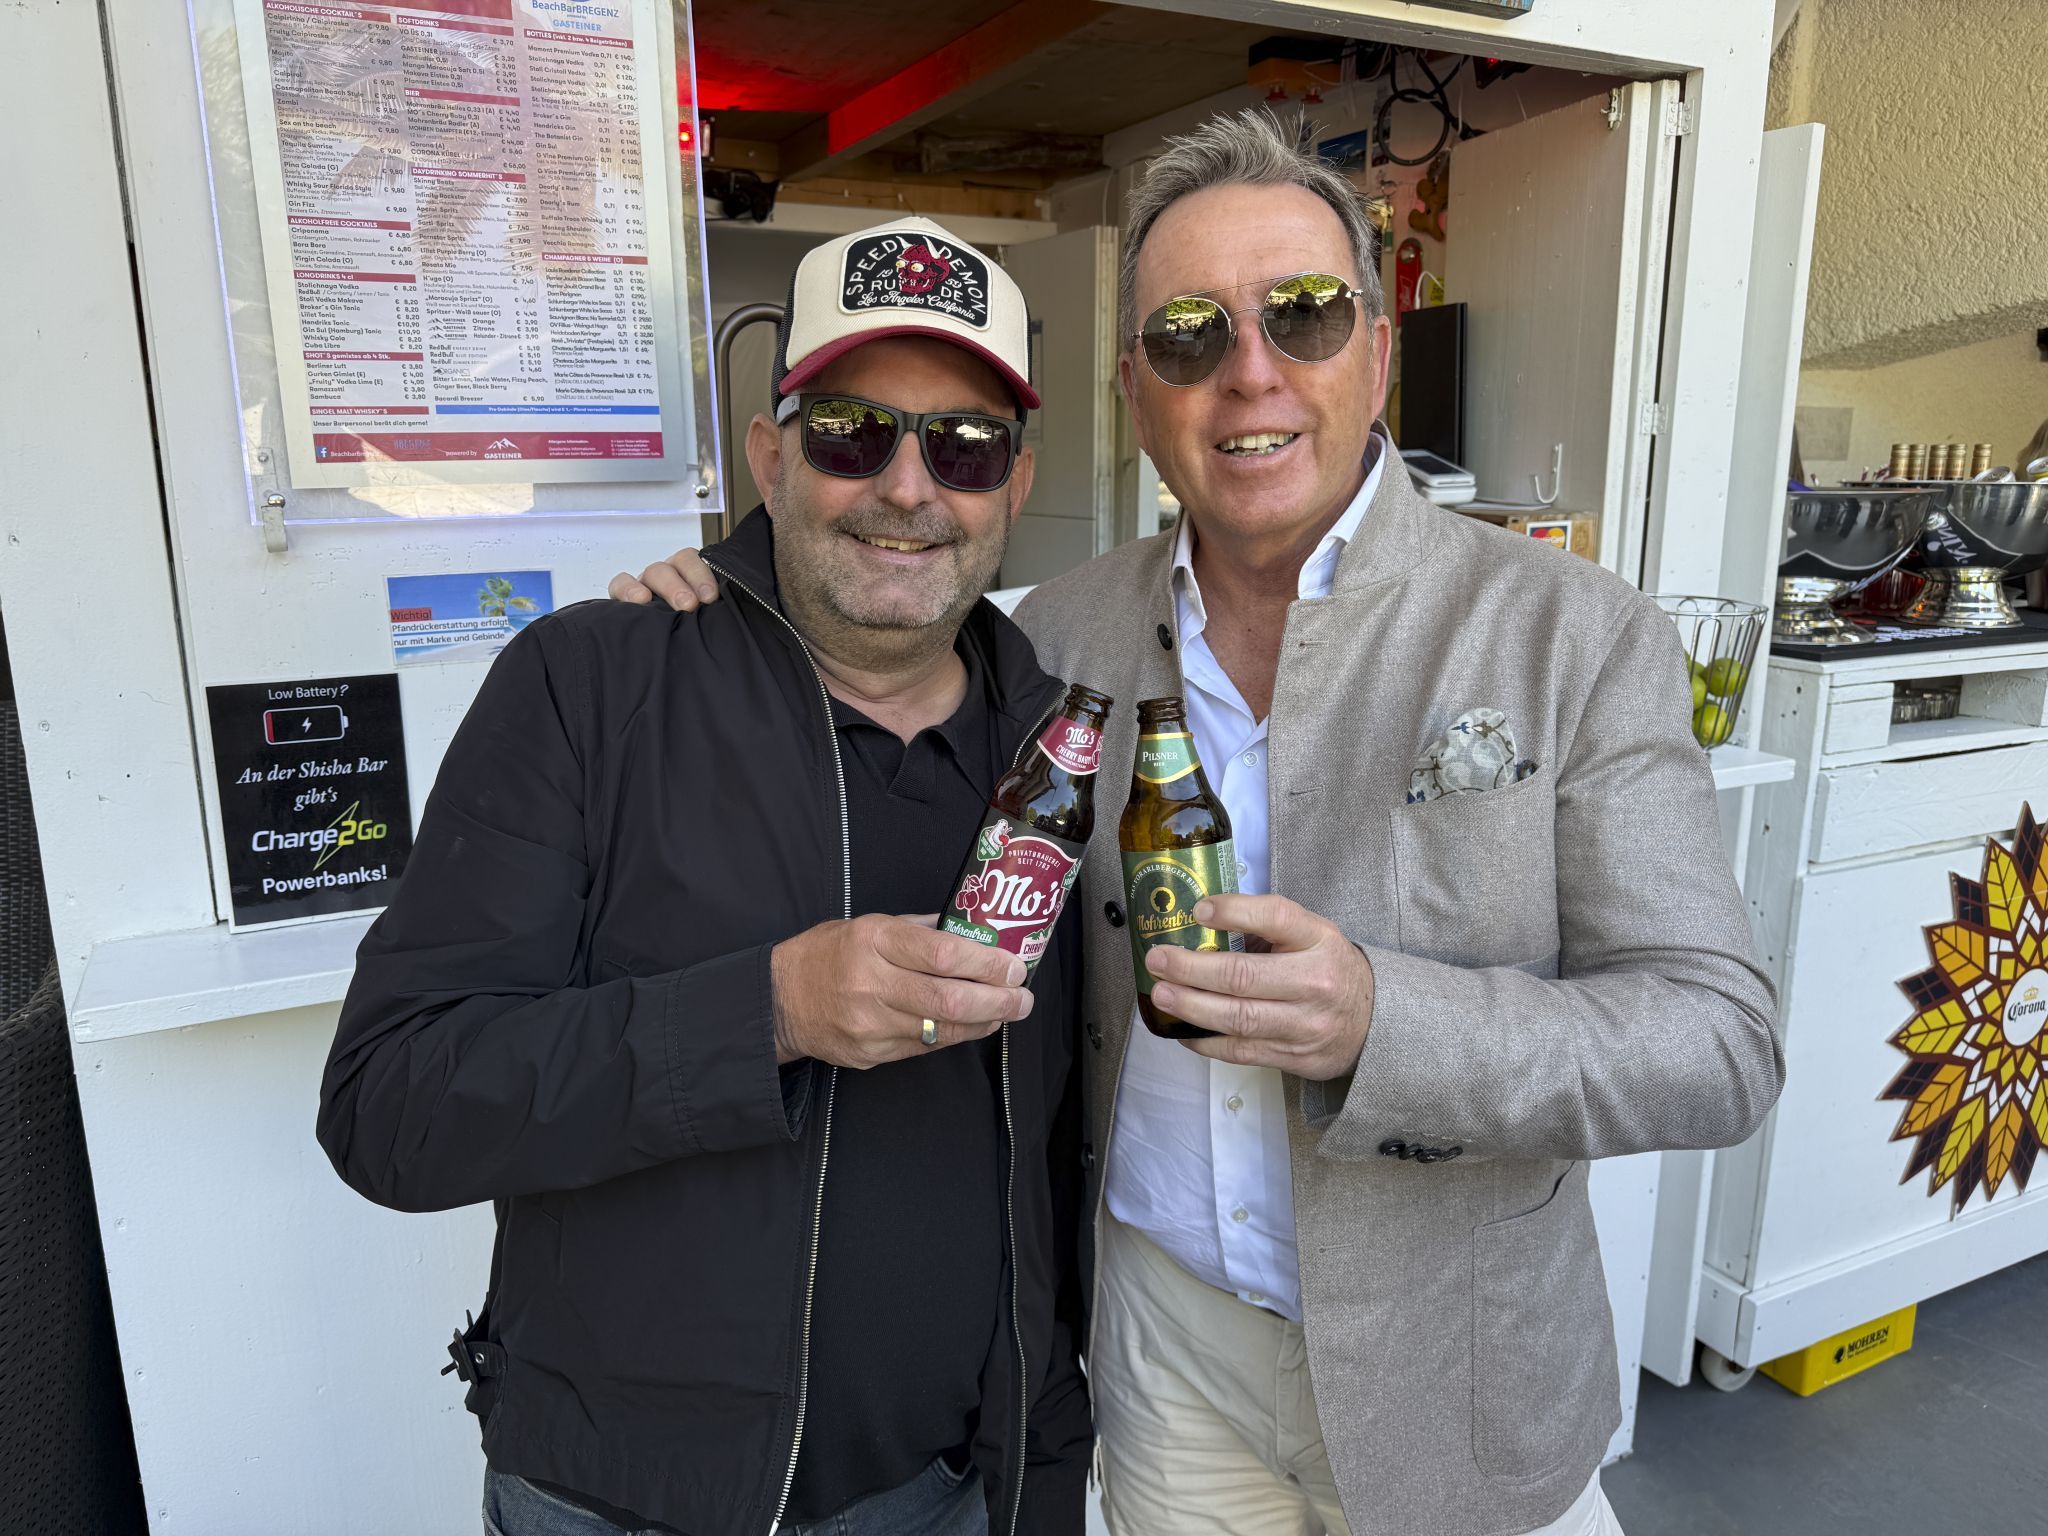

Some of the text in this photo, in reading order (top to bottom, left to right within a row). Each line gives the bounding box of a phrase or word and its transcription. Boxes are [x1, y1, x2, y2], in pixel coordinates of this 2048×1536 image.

[266, 2, 319, 13] ALKOHOLISCHE
[532, 0, 619, 18] BeachBarBREGENZ
[398, 17, 439, 27] SOFTDRINKS
[553, 20, 602, 31] GASTEINER
[271, 49, 294, 57] Mojito
[401, 45, 438, 55] GASTEINER
[554, 48, 580, 56] Premium
[402, 61, 425, 70] Mango
[426, 111, 449, 119] Cherry
[411, 148, 440, 156] CORONA
[412, 168, 457, 177] DAYDRINKING
[286, 181, 312, 189] Whisky
[340, 220, 378, 228] COCKTAILS
[296, 272, 340, 280] LONGDRINKS
[846, 239, 987, 315] SPEED DEMON
[857, 290, 976, 321] Los Angeles California
[391, 609, 432, 621] Wichtig!
[392, 618, 508, 633] Pfandrückerstattung erfolgt
[426, 635, 451, 644] Marke
[454, 633, 469, 642] und
[472, 631, 505, 641] Gebinde
[268, 684, 349, 700] Low Battery?
[1142, 751, 1178, 762] PILSNER
[236, 757, 388, 785] An der Shisha Bar
[252, 819, 386, 852] Charge2Go
[1008, 849, 1061, 868] PRIVATBRAUEREI
[1017, 857, 1034, 866] SEIT
[262, 865, 387, 894] Powerbanks!
[1137, 909, 1196, 931] Mohrenbr
[944, 918, 993, 944] Mohrenbräu
[2007, 999, 2046, 1022] Corona
[1847, 1325, 1889, 1353] MOHREN
